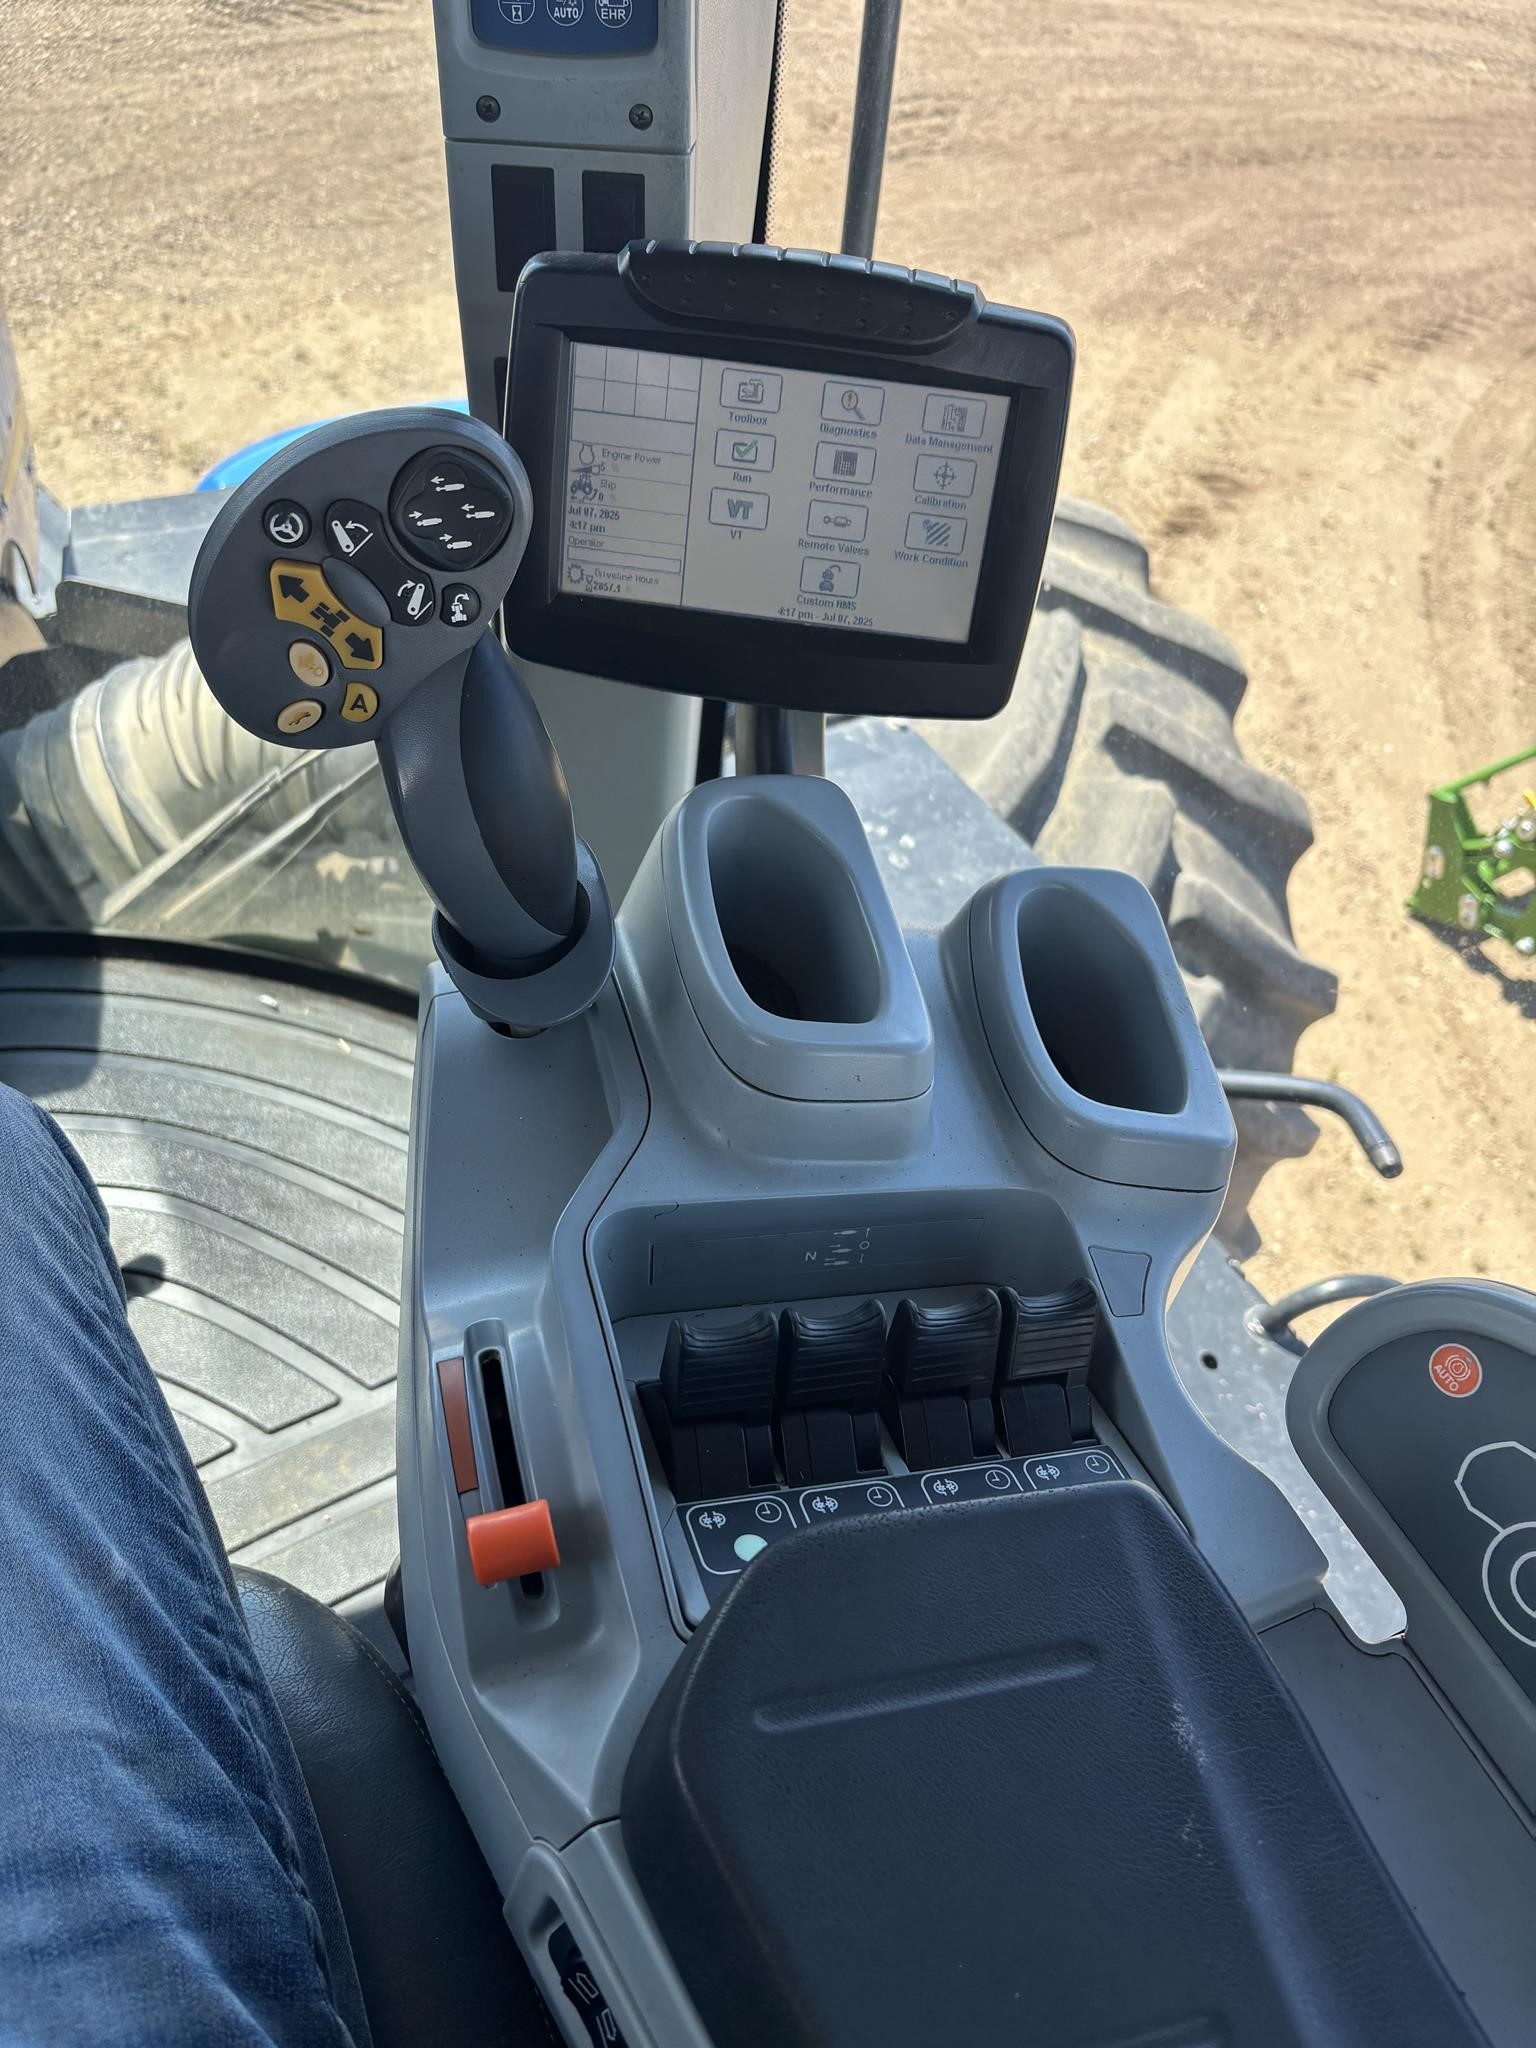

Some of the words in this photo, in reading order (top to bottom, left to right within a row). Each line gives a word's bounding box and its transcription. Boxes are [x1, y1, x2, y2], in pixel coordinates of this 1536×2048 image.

[553, 8, 579, 20] AUTO
[600, 8, 627, 20] EHR
[729, 411, 768, 426] Toolbox
[819, 423, 877, 439] Diagnostics
[905, 433, 927, 446] Data
[928, 437, 993, 454] Management
[602, 448, 632, 461] Engine
[634, 452, 661, 464] Power
[600, 479, 617, 490] Slip
[732, 472, 752, 483] Run
[809, 481, 873, 498] Performance
[915, 495, 967, 510] Calibration
[568, 535, 605, 548] Operator
[730, 530, 742, 540] VT
[798, 538, 835, 551] Remote
[838, 543, 870, 556] Valves
[894, 550, 920, 562] Work
[922, 554, 968, 568] Condition
[594, 568, 633, 581] Driveline
[635, 573, 660, 584] Hours
[796, 595, 834, 608] Custom
[798, 611, 814, 621] pm
[822, 611, 836, 622] Jul
[852, 615, 873, 627] 2025
[350, 693, 368, 713] A
[1433, 1363, 1460, 1392] AUTO
